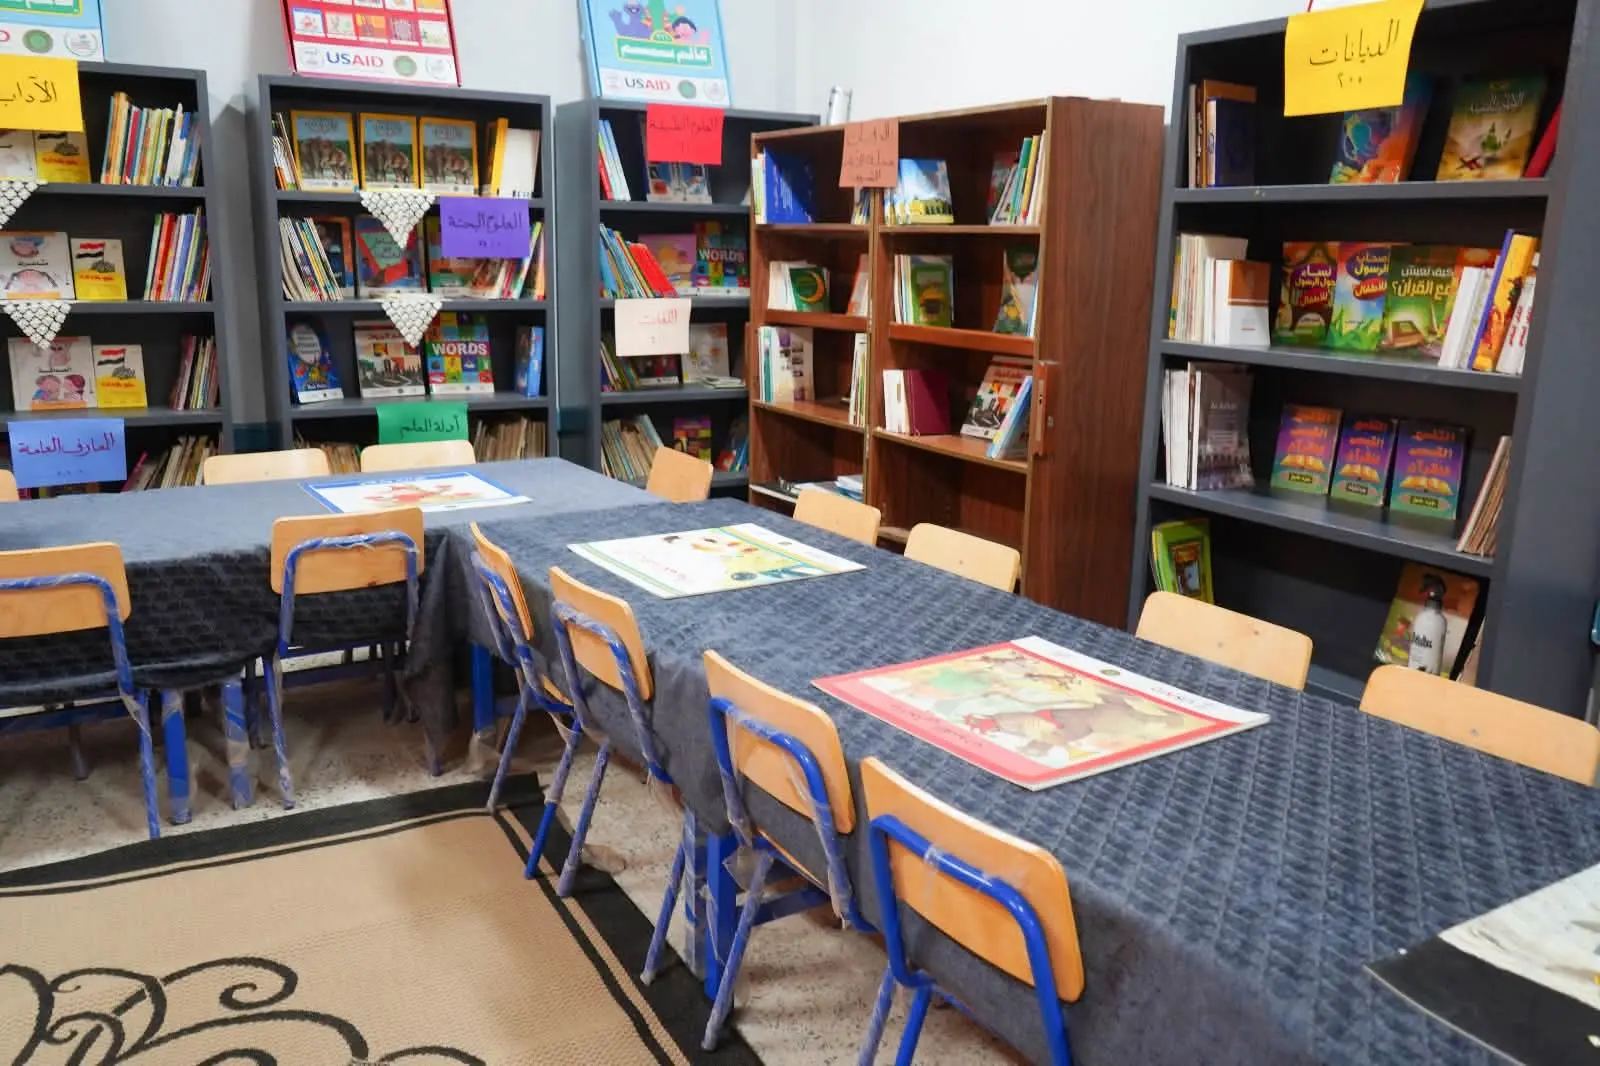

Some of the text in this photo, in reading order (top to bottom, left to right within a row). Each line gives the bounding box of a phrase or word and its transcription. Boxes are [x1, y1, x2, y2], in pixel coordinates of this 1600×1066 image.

[1308, 20, 1400, 66] الديانات
[326, 51, 384, 68] USAID
[677, 46, 707, 63] عالم
[624, 77, 670, 91] USAID
[448, 211, 522, 234] العلوم البحتة
[698, 249, 745, 264] WORDS
[1354, 263, 1390, 276] الرسول
[1434, 284, 1450, 300] مع
[638, 308, 678, 329] اللغات
[432, 343, 488, 356] WORDS
[18, 432, 115, 457] المعارف العامة
